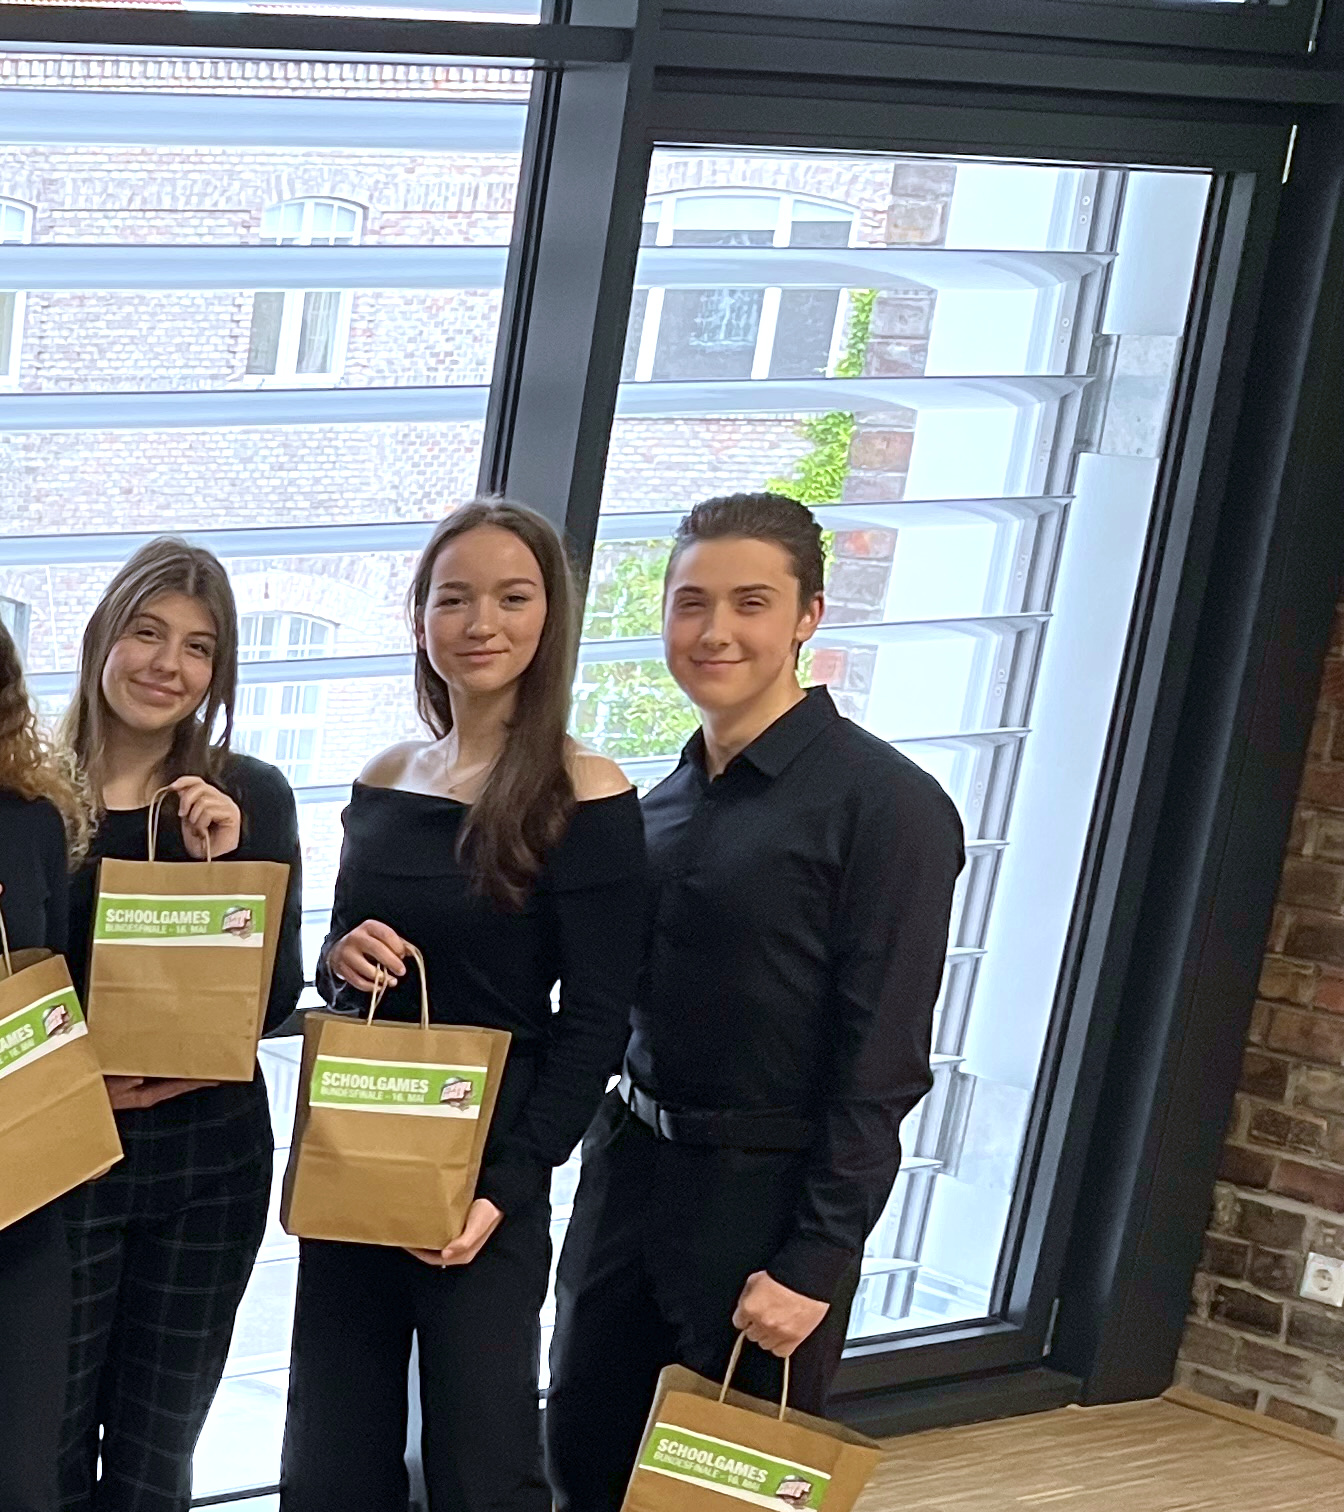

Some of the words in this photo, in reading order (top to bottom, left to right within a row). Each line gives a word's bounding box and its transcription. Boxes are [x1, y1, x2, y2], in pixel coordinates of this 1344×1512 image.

[106, 909, 211, 924] SCHOOLGAMES
[321, 1072, 429, 1093] SCHOOLGAMES
[320, 1086, 383, 1100] BUNDESFINALE
[407, 1094, 425, 1103] MAI
[657, 1438, 768, 1483] SCHOOLGAMES
